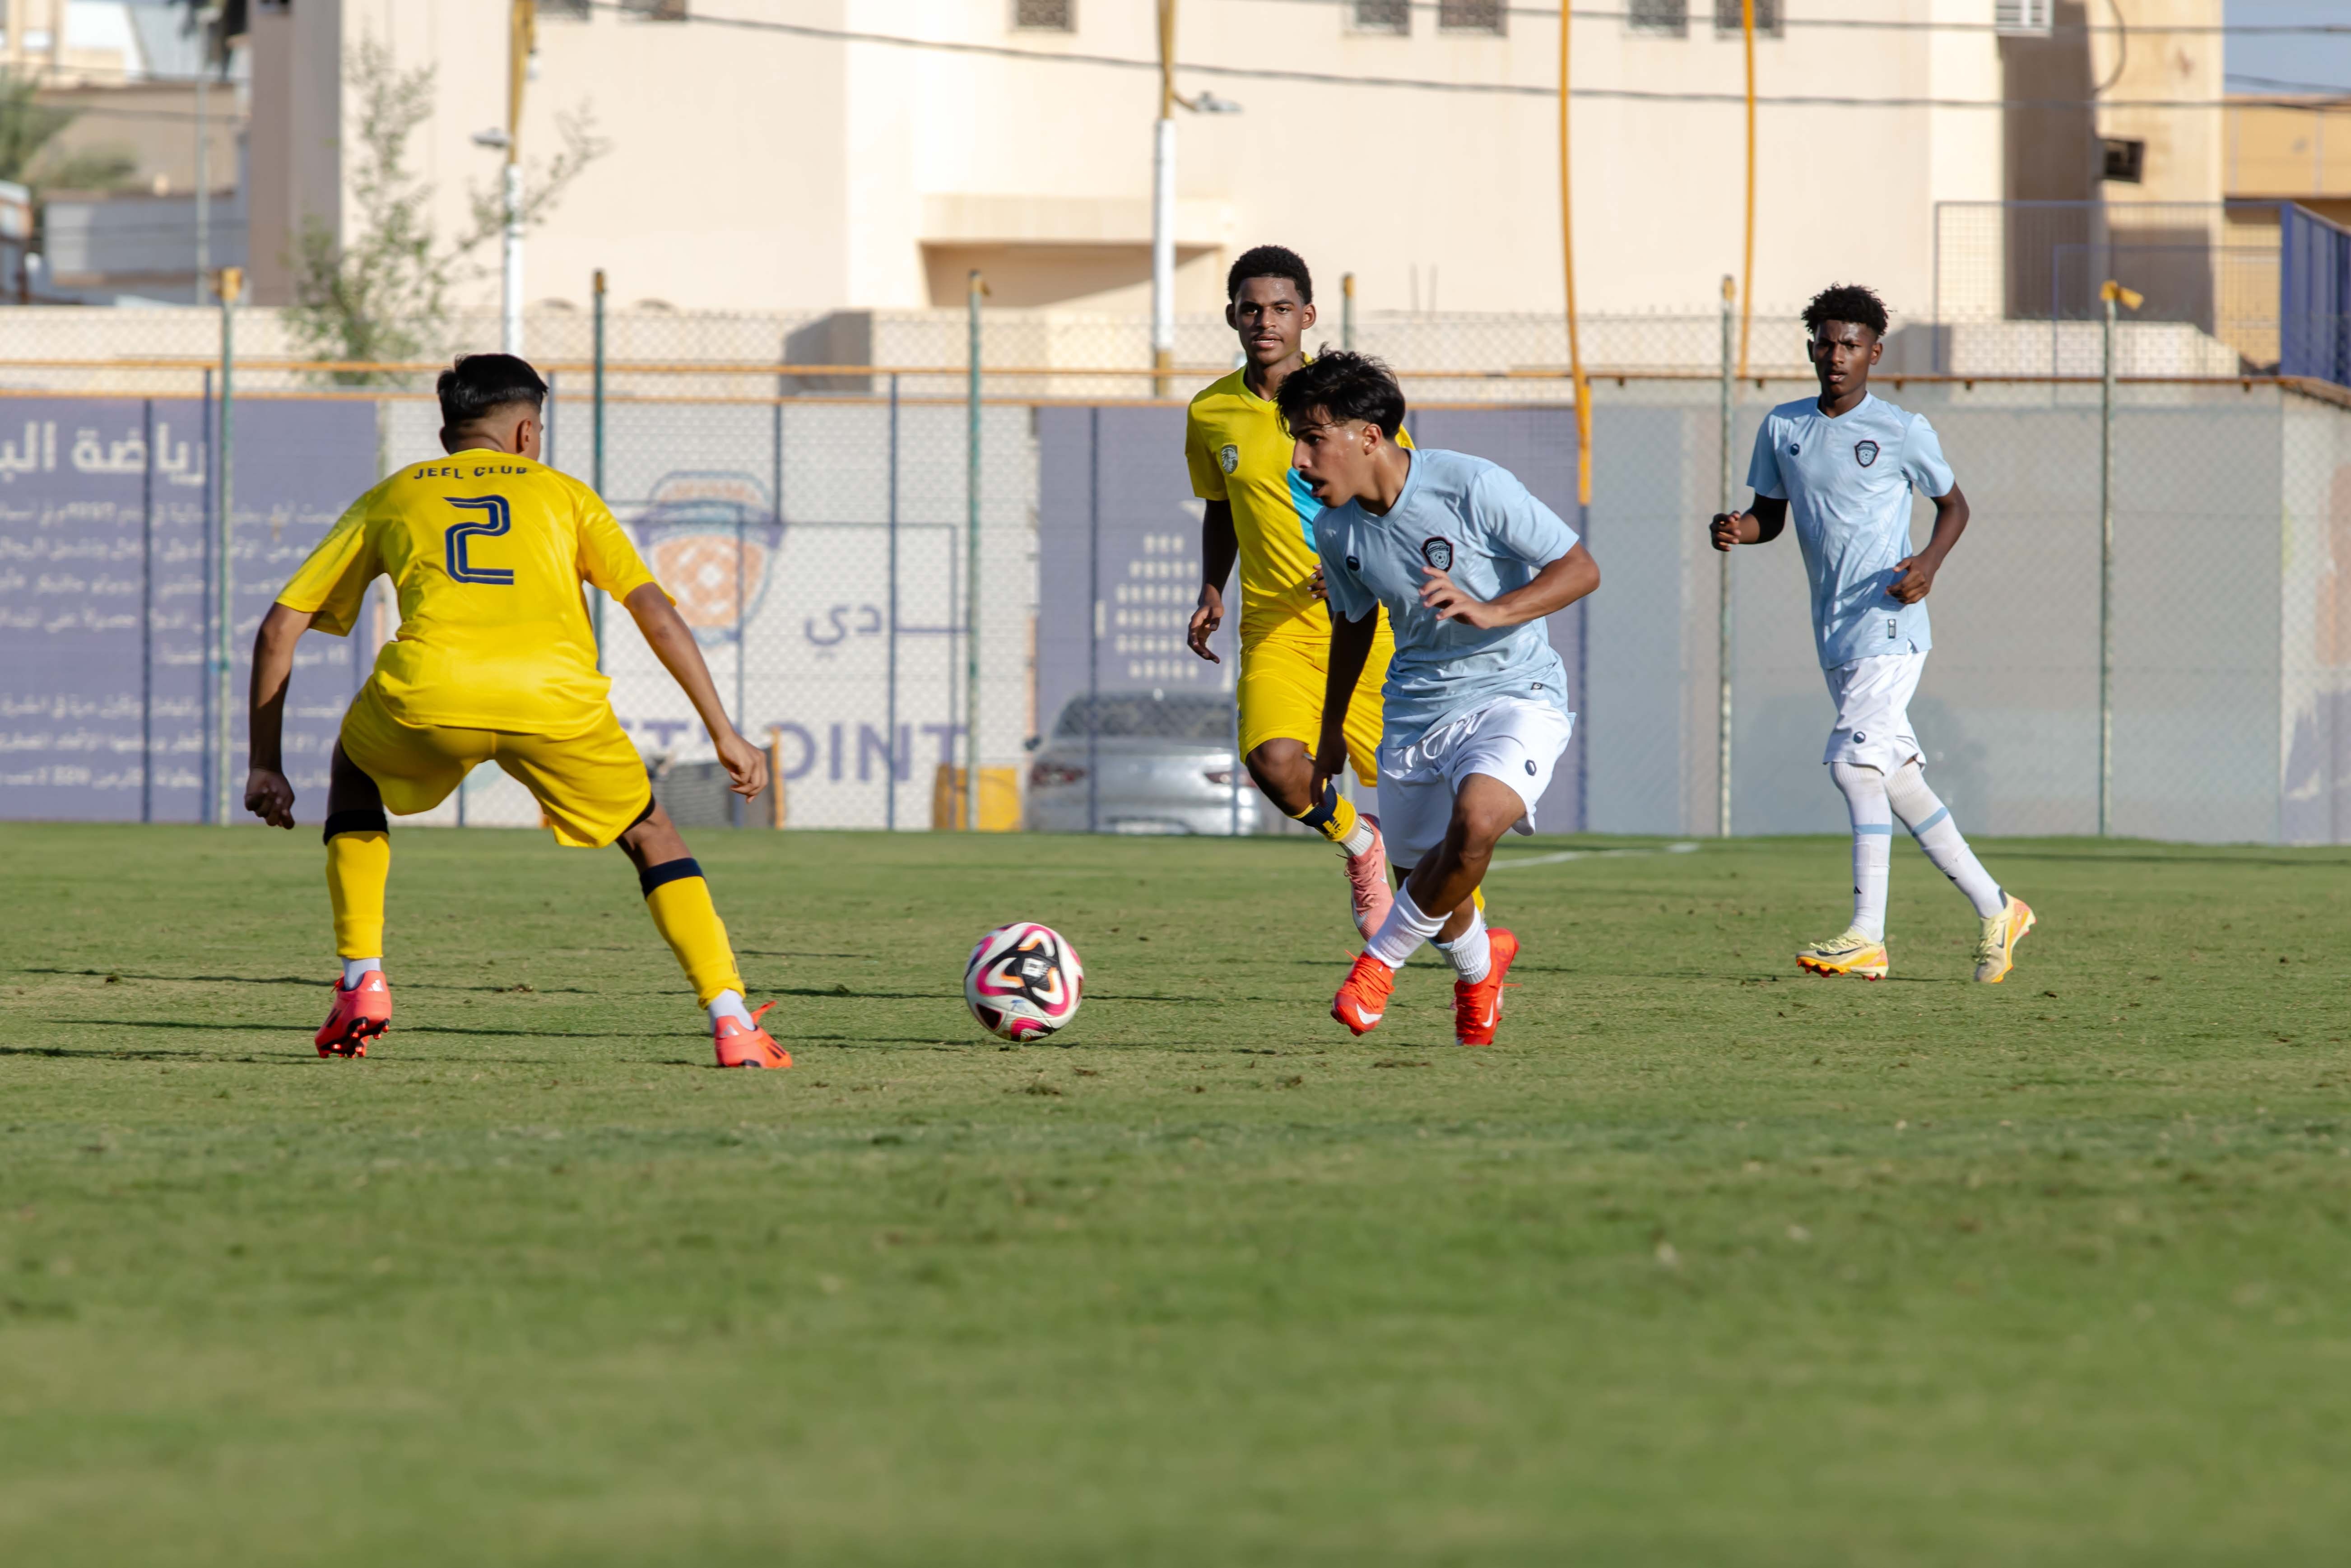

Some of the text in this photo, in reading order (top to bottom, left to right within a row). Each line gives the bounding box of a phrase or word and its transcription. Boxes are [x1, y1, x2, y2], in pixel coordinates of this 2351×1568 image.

[414, 465, 527, 479] JEEL CLUB
[442, 494, 515, 585] 2
